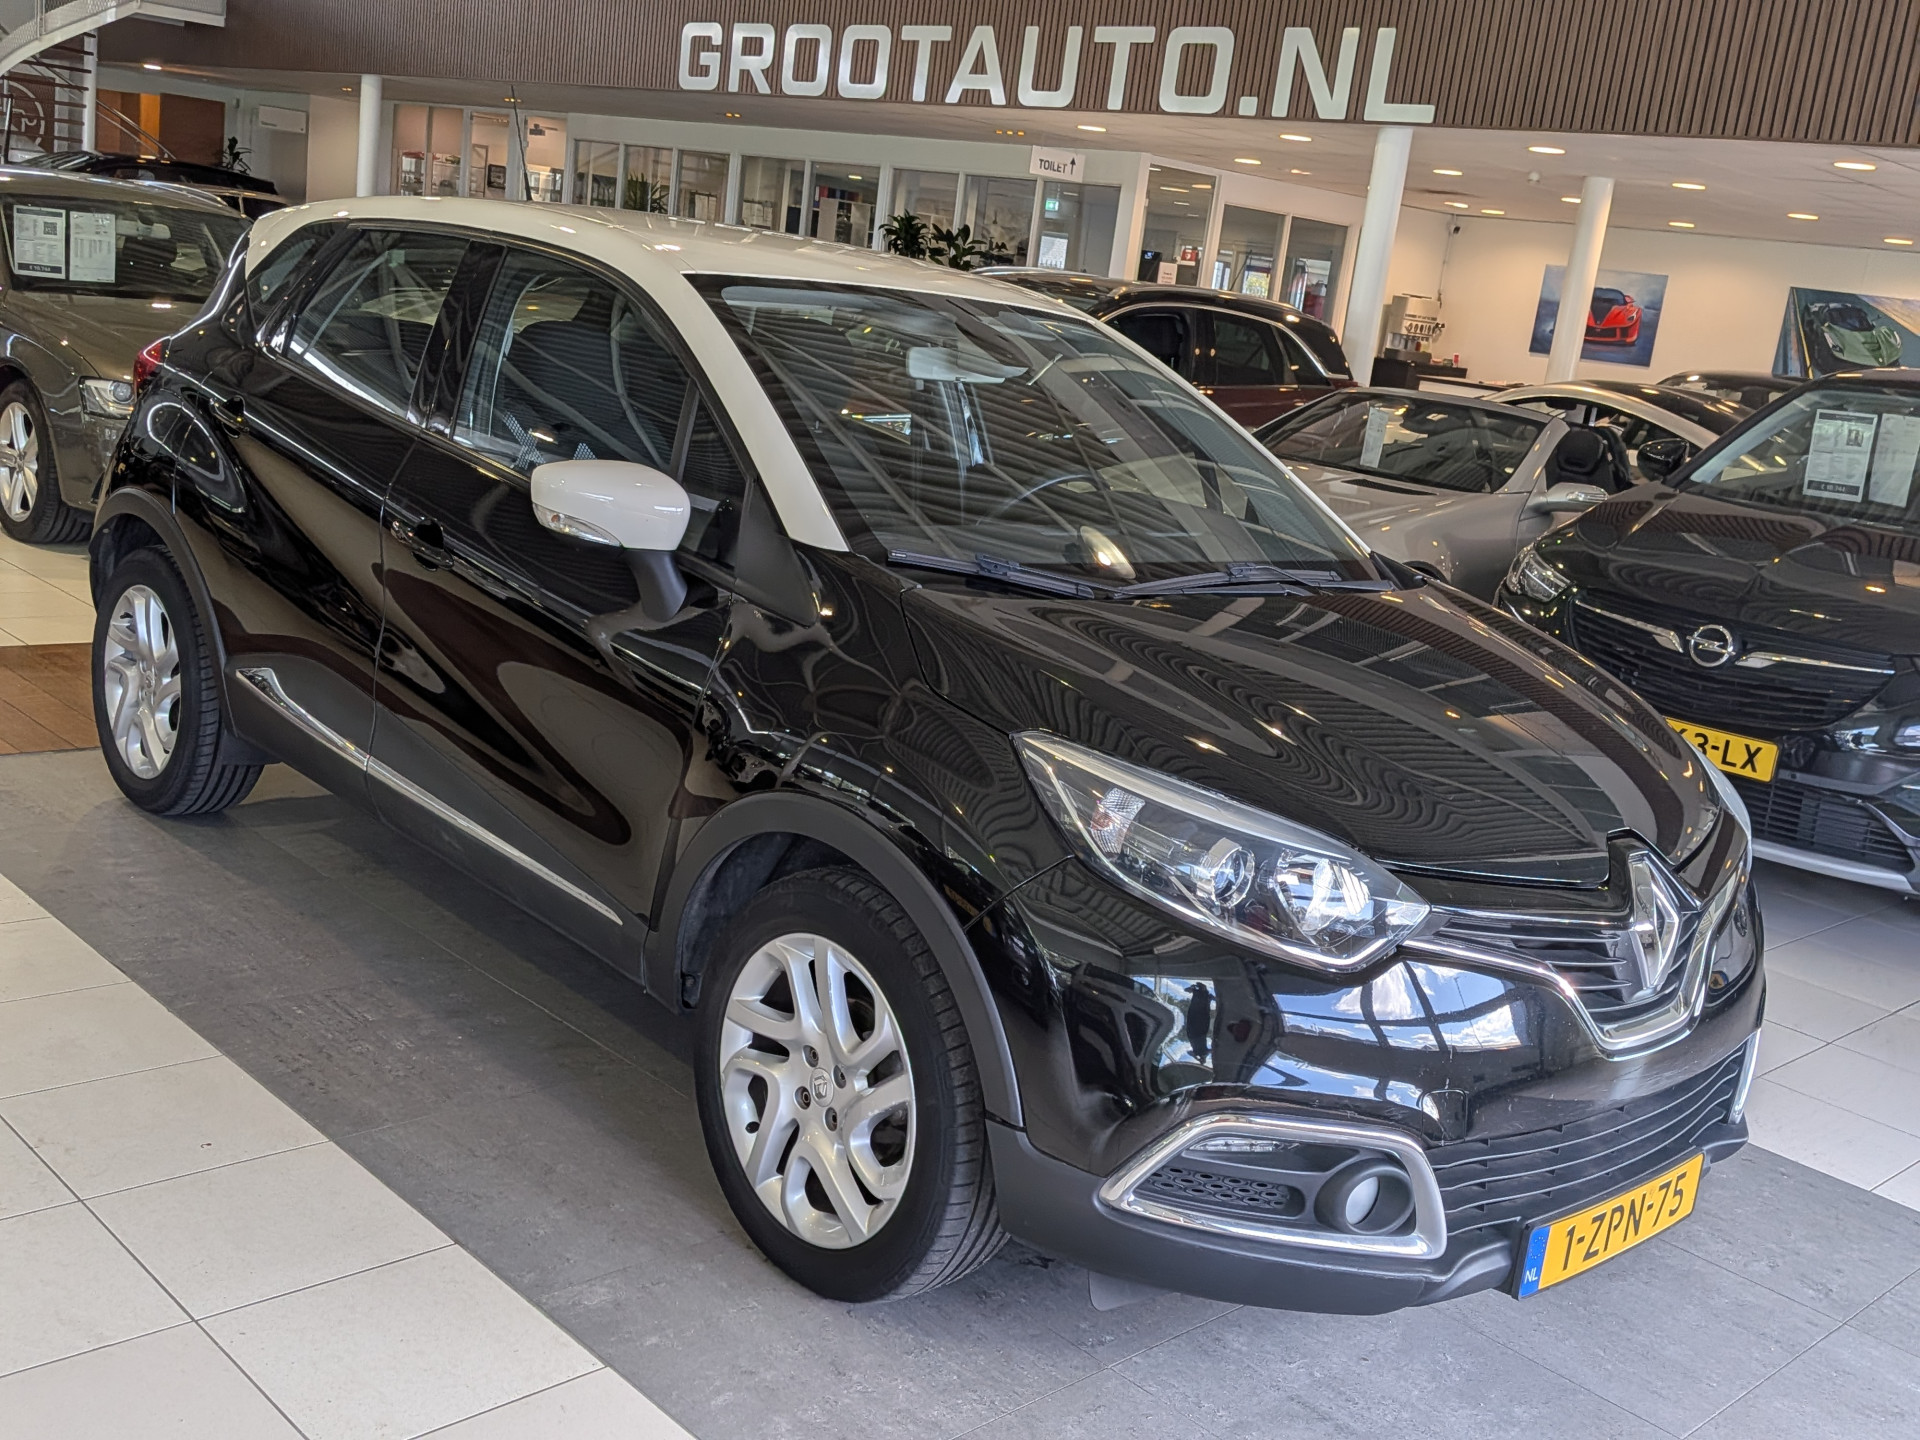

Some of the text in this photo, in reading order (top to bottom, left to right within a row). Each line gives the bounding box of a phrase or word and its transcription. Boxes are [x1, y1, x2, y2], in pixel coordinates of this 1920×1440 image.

[678, 22, 1436, 123] GROOTAUTO.NL
[1039, 158, 1068, 174] TOILET
[1677, 728, 1763, 773] 3-LX
[1524, 1170, 1688, 1284] NL 1-ZPN-75
